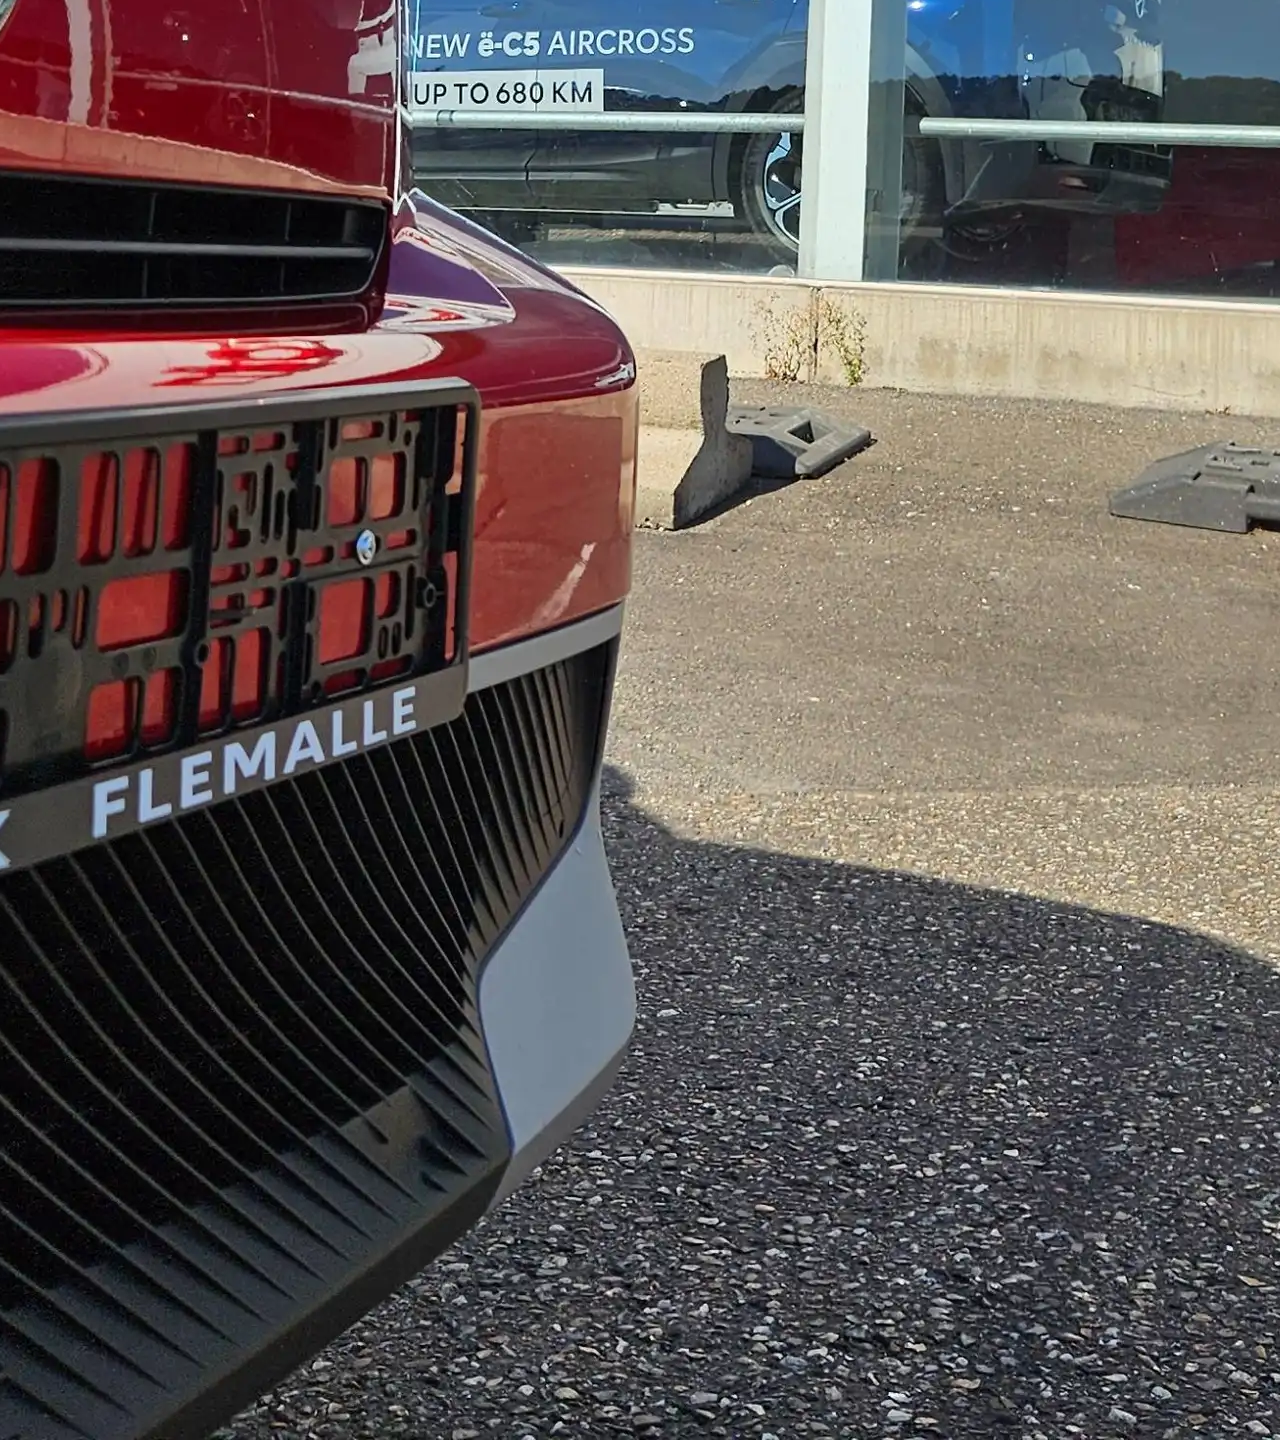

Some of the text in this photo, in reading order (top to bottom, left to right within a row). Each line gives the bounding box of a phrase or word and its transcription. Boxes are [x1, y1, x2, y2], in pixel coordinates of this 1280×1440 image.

[410, 28, 695, 59] NEW ë-C5 AIRCROSS
[414, 82, 593, 105] UP TO 680 KM
[90, 685, 417, 838] FLEMALLE
